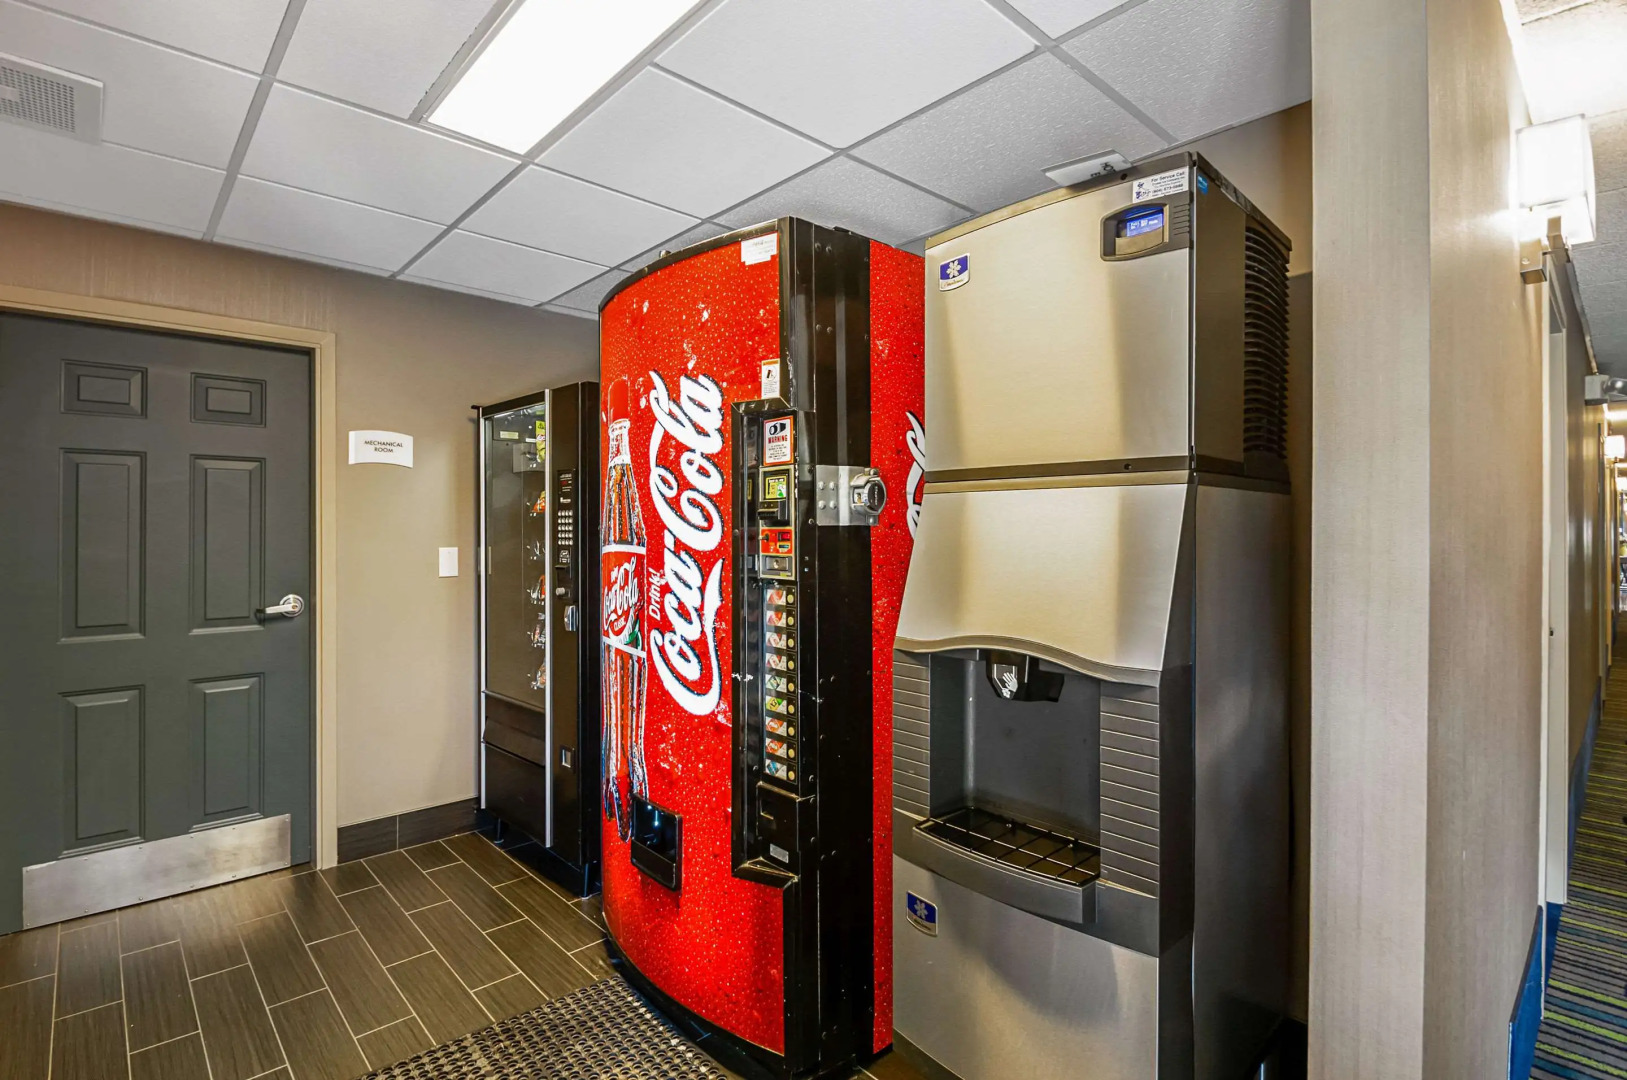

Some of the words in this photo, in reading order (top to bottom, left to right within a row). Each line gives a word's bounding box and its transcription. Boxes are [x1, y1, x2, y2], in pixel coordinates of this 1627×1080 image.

[364, 440, 403, 448] MECHANICAL
[768, 434, 788, 444] WARNING
[649, 369, 725, 716] Coca-Cola
[648, 567, 660, 621] Drink!
